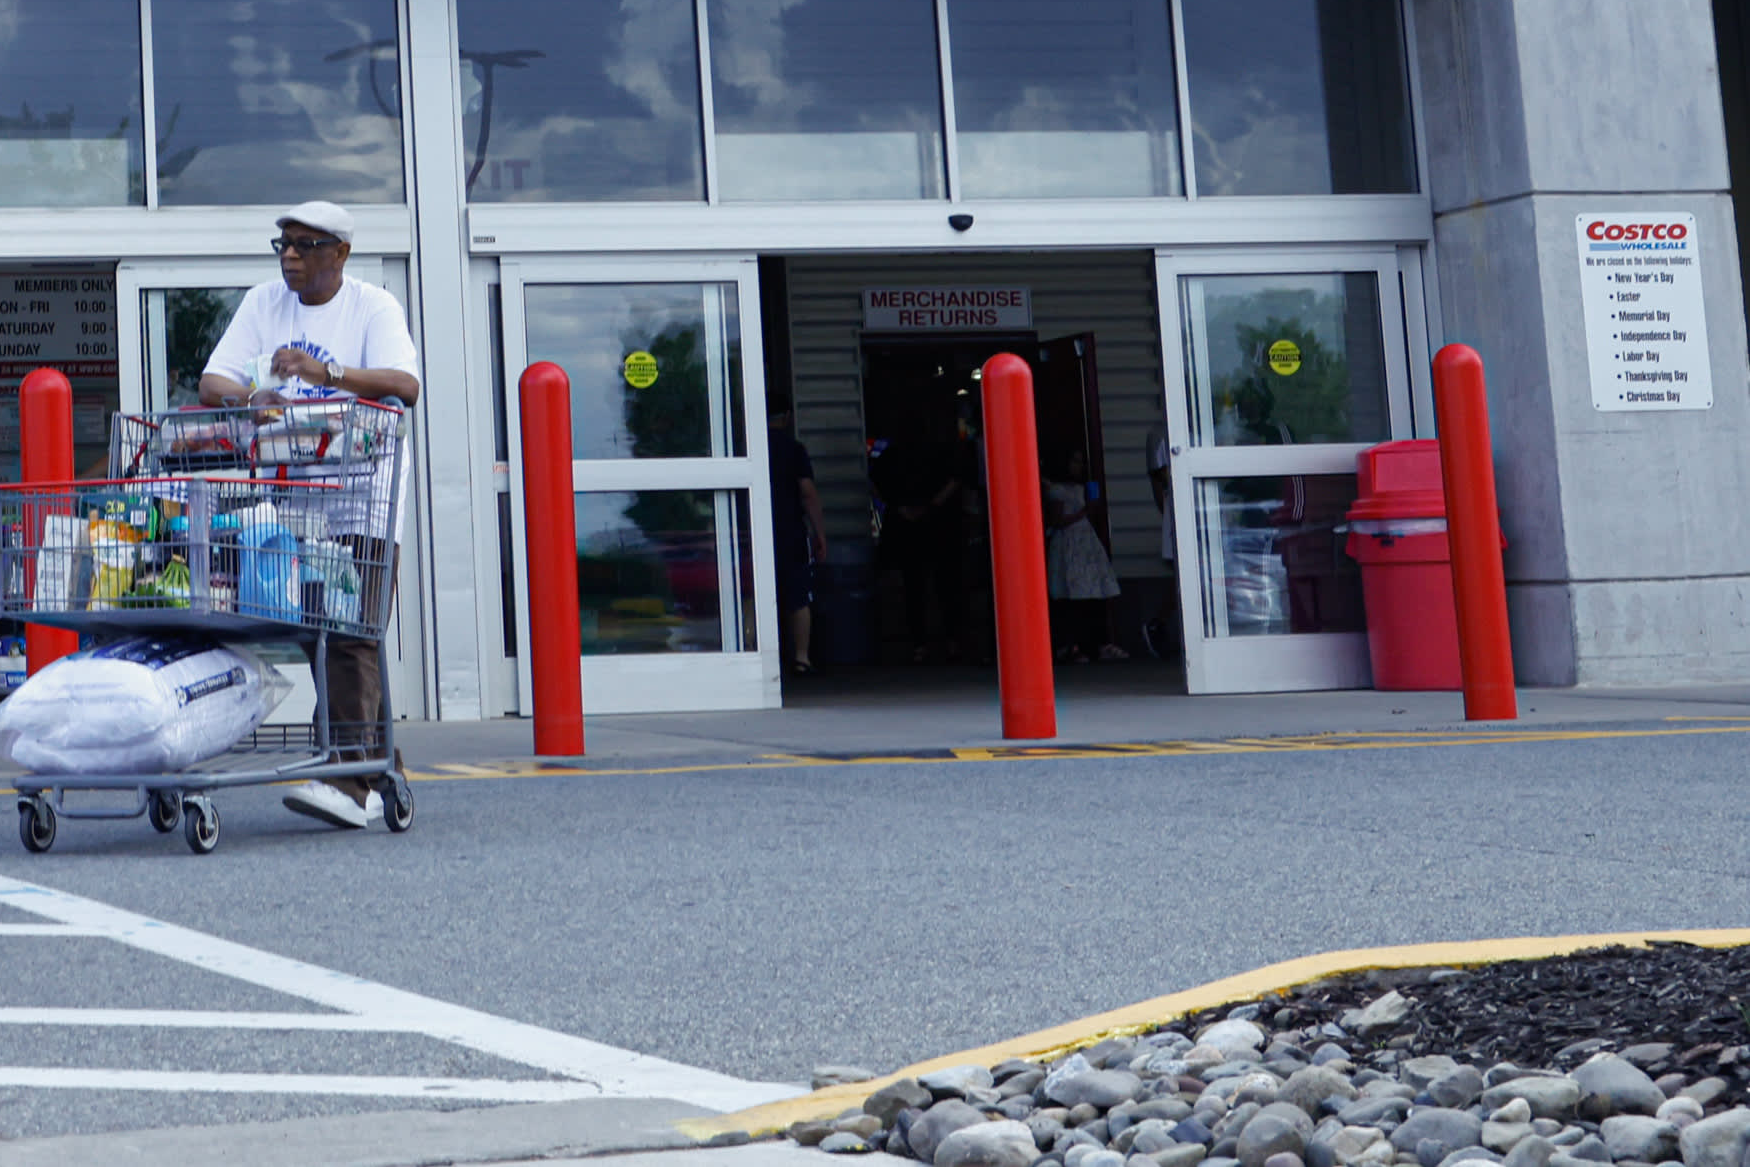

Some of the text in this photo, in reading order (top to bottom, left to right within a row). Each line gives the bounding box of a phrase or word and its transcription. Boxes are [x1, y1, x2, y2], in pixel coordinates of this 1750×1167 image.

[1586, 221, 1687, 241] COSTCO
[1620, 242, 1687, 251] WHOLESALE
[1615, 272, 1674, 284] New Year's Day
[15, 279, 114, 292] MEMBERS ONLY
[870, 290, 1023, 308] MERCHANDISE
[1617, 291, 1640, 302] Easter
[29, 301, 50, 314] FRI
[74, 300, 106, 313] 10:00
[899, 309, 998, 326] RETURNS
[1619, 310, 1671, 323] Memorial Day
[82, 322, 107, 334] 9:00
[1621, 330, 1687, 342] Independence Day
[76, 342, 107, 355] 10:00
[1622, 350, 1660, 363] Labor Day
[1625, 370, 1688, 383] Thanksgiving Day
[1627, 390, 1680, 403] Christmas Day
